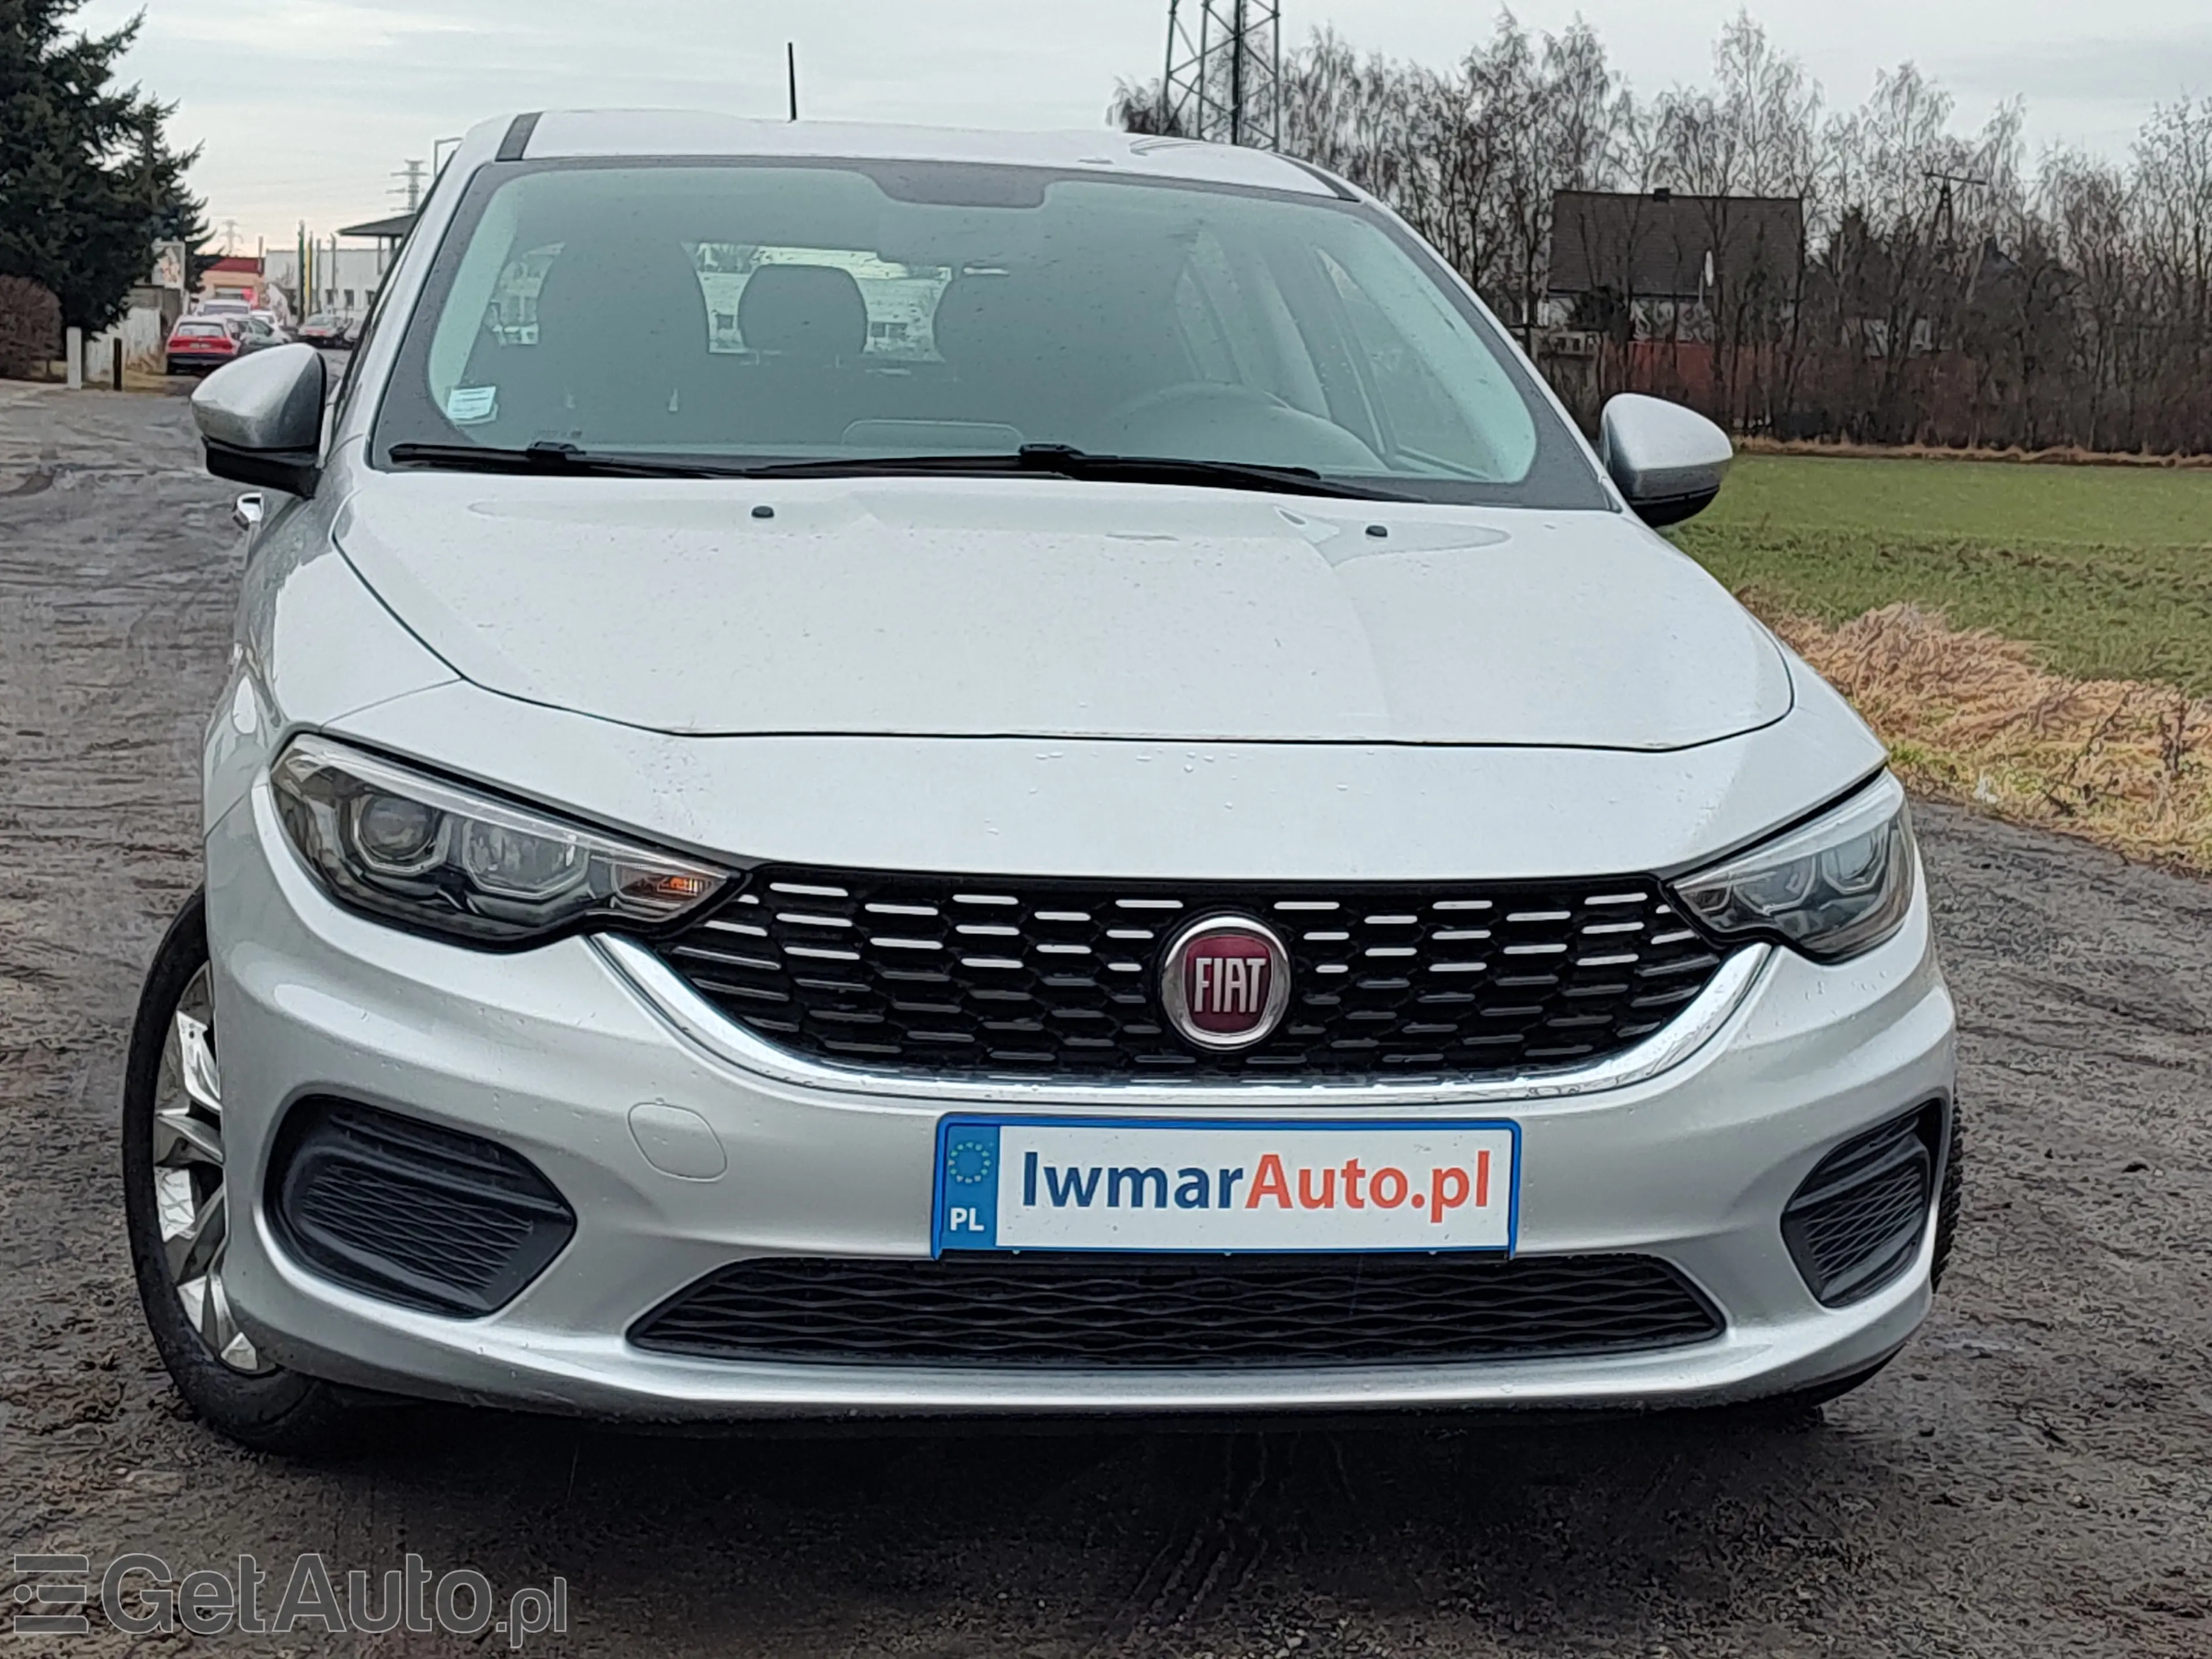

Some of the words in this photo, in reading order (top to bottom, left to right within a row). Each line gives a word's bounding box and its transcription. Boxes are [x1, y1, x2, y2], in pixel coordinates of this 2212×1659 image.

[1194, 957, 1266, 1012] FIAT
[1022, 1151, 1489, 1223] IwmarAuto.pl
[950, 1207, 984, 1231] PL
